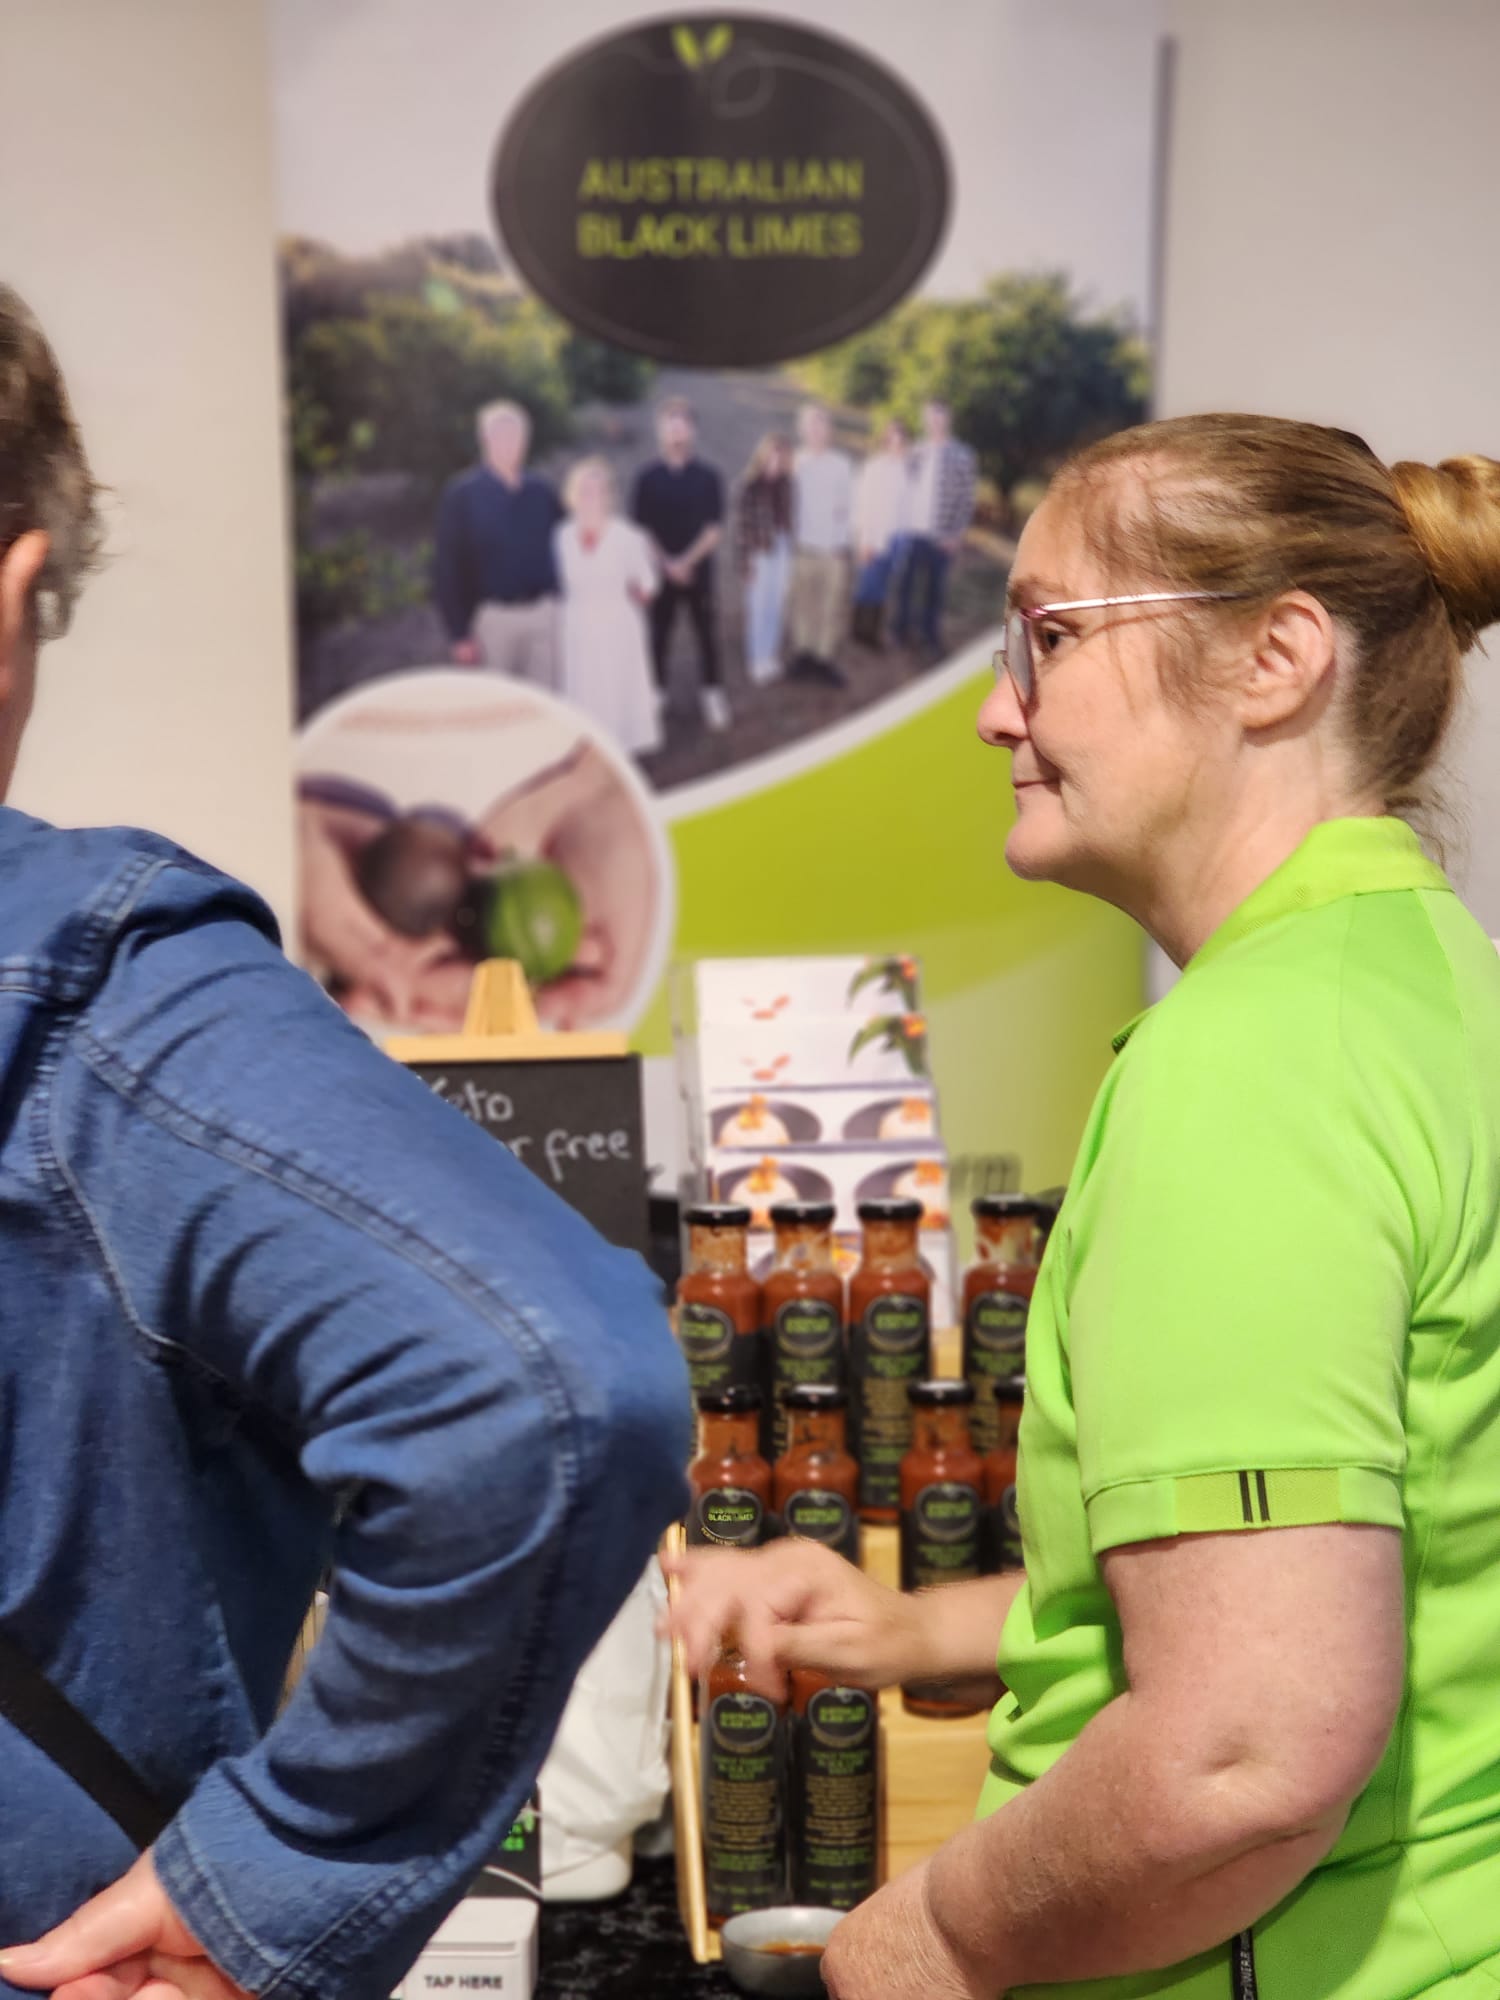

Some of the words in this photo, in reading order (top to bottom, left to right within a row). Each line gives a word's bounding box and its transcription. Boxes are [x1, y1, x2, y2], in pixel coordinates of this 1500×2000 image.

[580, 158, 864, 202] AUSTRALIAN
[577, 212, 719, 259] BLACK
[727, 212, 863, 259] LIMES
[544, 1128, 631, 1181] free
[424, 1974, 455, 1990] TAP
[459, 1974, 503, 1990] HERE
